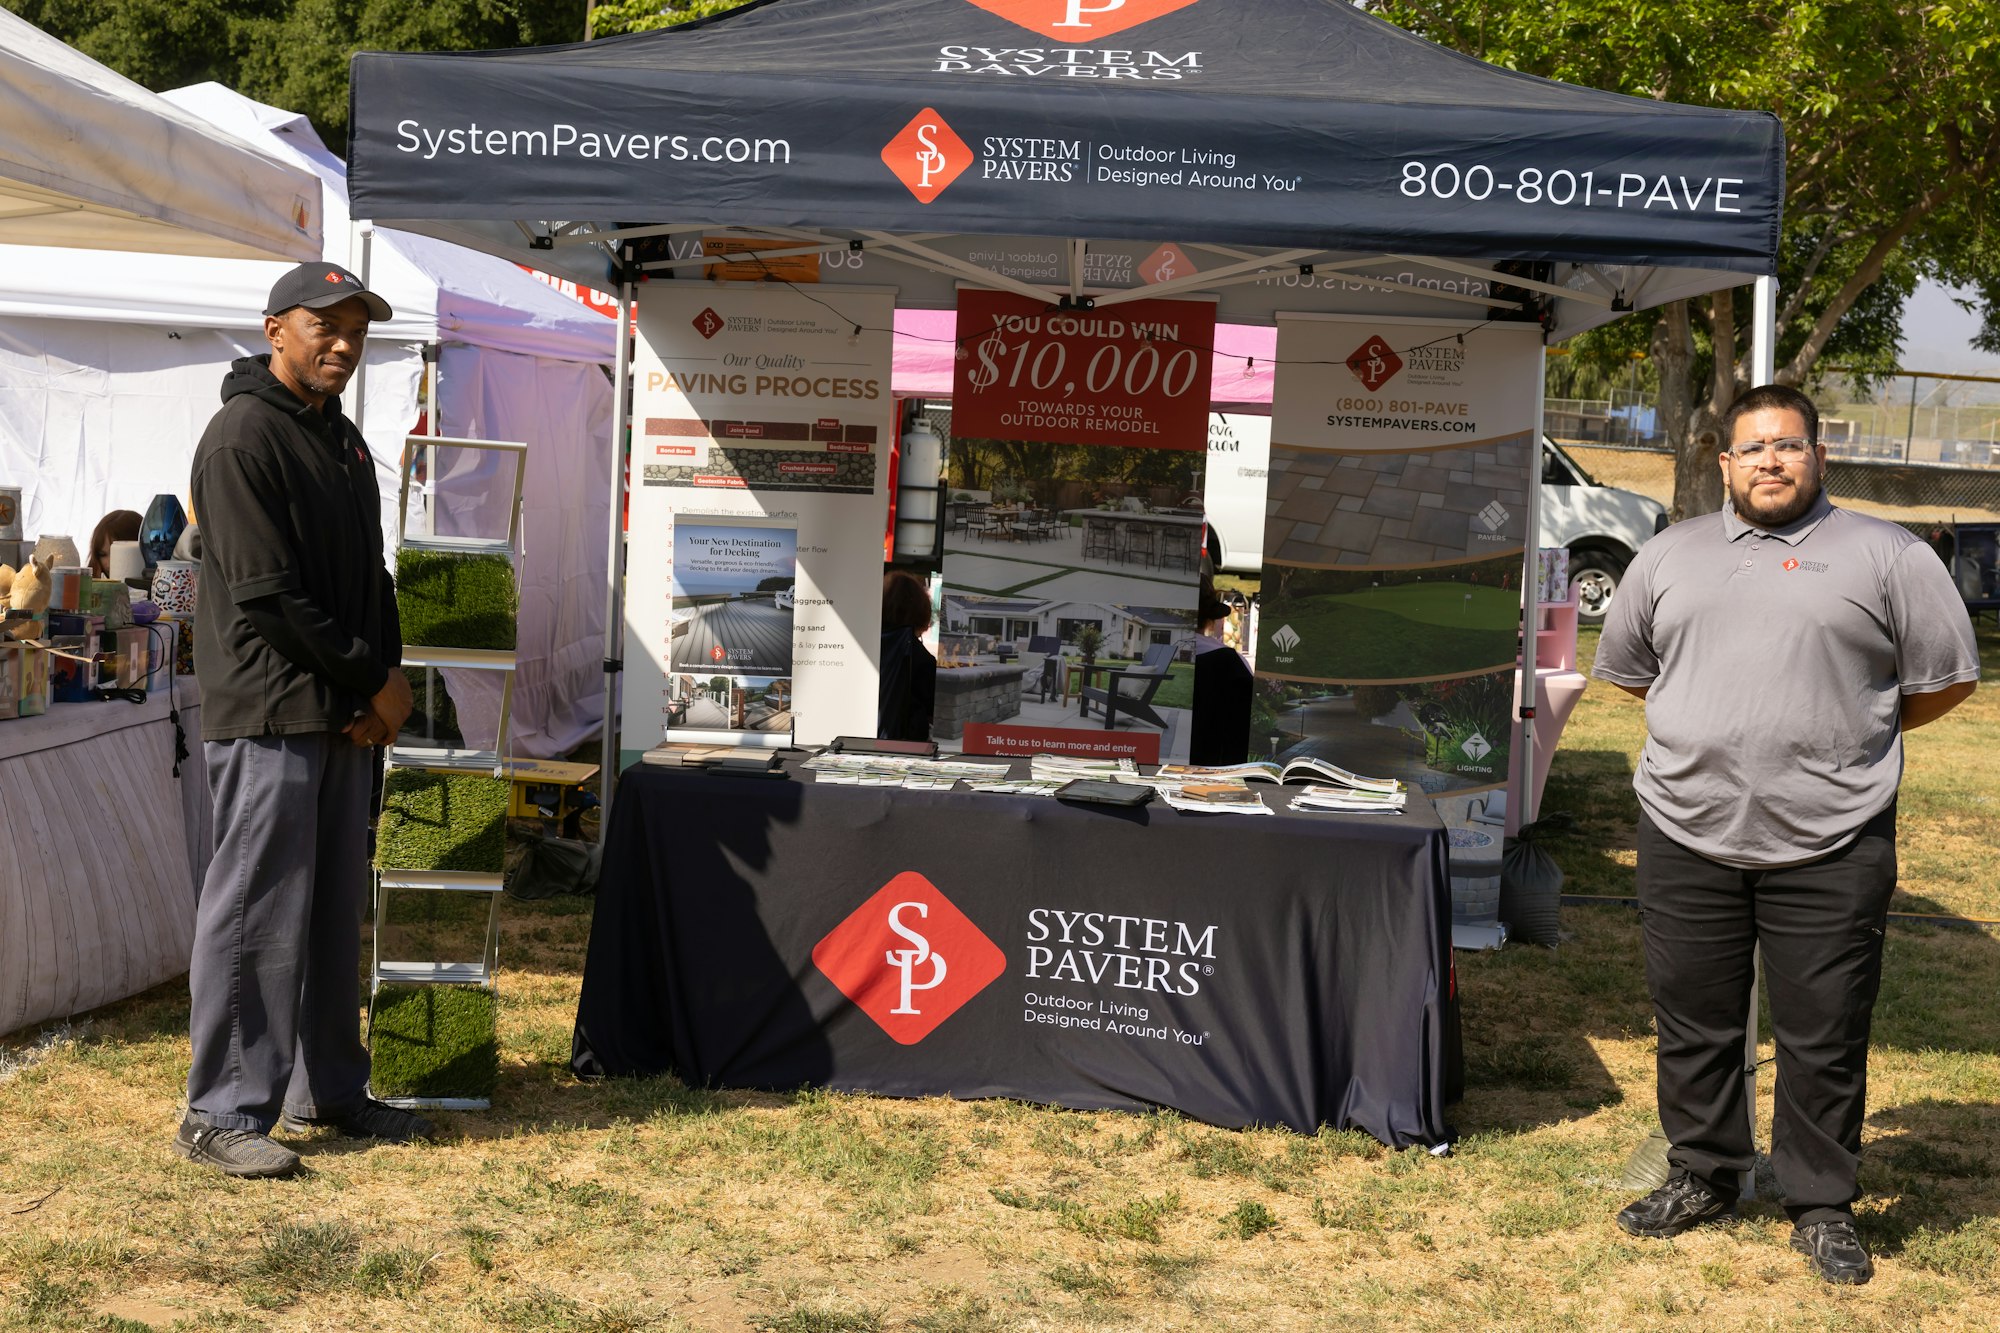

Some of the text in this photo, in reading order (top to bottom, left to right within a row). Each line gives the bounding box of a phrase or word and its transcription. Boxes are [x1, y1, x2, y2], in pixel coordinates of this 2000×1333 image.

[938, 46, 1203, 67] SYSTEM
[396, 119, 791, 165] SystemPavers.com
[983, 136, 1081, 160] SYSTEM
[1098, 144, 1236, 168] Outdoor Living
[1098, 166, 1183, 186] Designed
[1188, 171, 1256, 189] Around
[1400, 161, 1744, 214] 800-801-PAVE
[727, 317, 762, 326] SYSTEM
[767, 318, 816, 328] Outdoor Living
[767, 326, 798, 334] Designed
[992, 314, 1179, 341] YOU COULD WIN
[723, 353, 805, 371] Our Quality
[1409, 346, 1465, 360] SYSTEM
[967, 331, 1198, 398] $10,000
[647, 372, 880, 400] PAVING PROCESS
[1018, 400, 1143, 419] TOWARDS YOUR
[1336, 397, 1469, 416] (800) 801-PAVE
[1000, 413, 1160, 434] OUTDOOR REMODEL
[1327, 415, 1476, 433] SYSTEMPAVERS.COM
[804, 465, 834, 473] Aggregate
[682, 507, 719, 515] Demolish
[721, 507, 734, 515] the
[736, 509, 767, 517] existing
[768, 510, 798, 518] surface
[689, 537, 709, 545] Your
[732, 538, 781, 548] Destination
[1477, 533, 1506, 542] PAVERS
[710, 547, 760, 558] for Decking
[812, 545, 828, 553] flow
[1801, 560, 1829, 568] SYSTEM
[805, 642, 816, 650] lay
[1275, 656, 1294, 664] TURF
[986, 735, 1137, 753] Talk to us to learn more and enter
[1456, 765, 1492, 773] LIGHTING
[1026, 908, 1219, 959] SYSTEM
[1024, 992, 1150, 1021] Outdoor Living
[1024, 1010, 1101, 1032] Designed
[1105, 1020, 1167, 1041] Around
